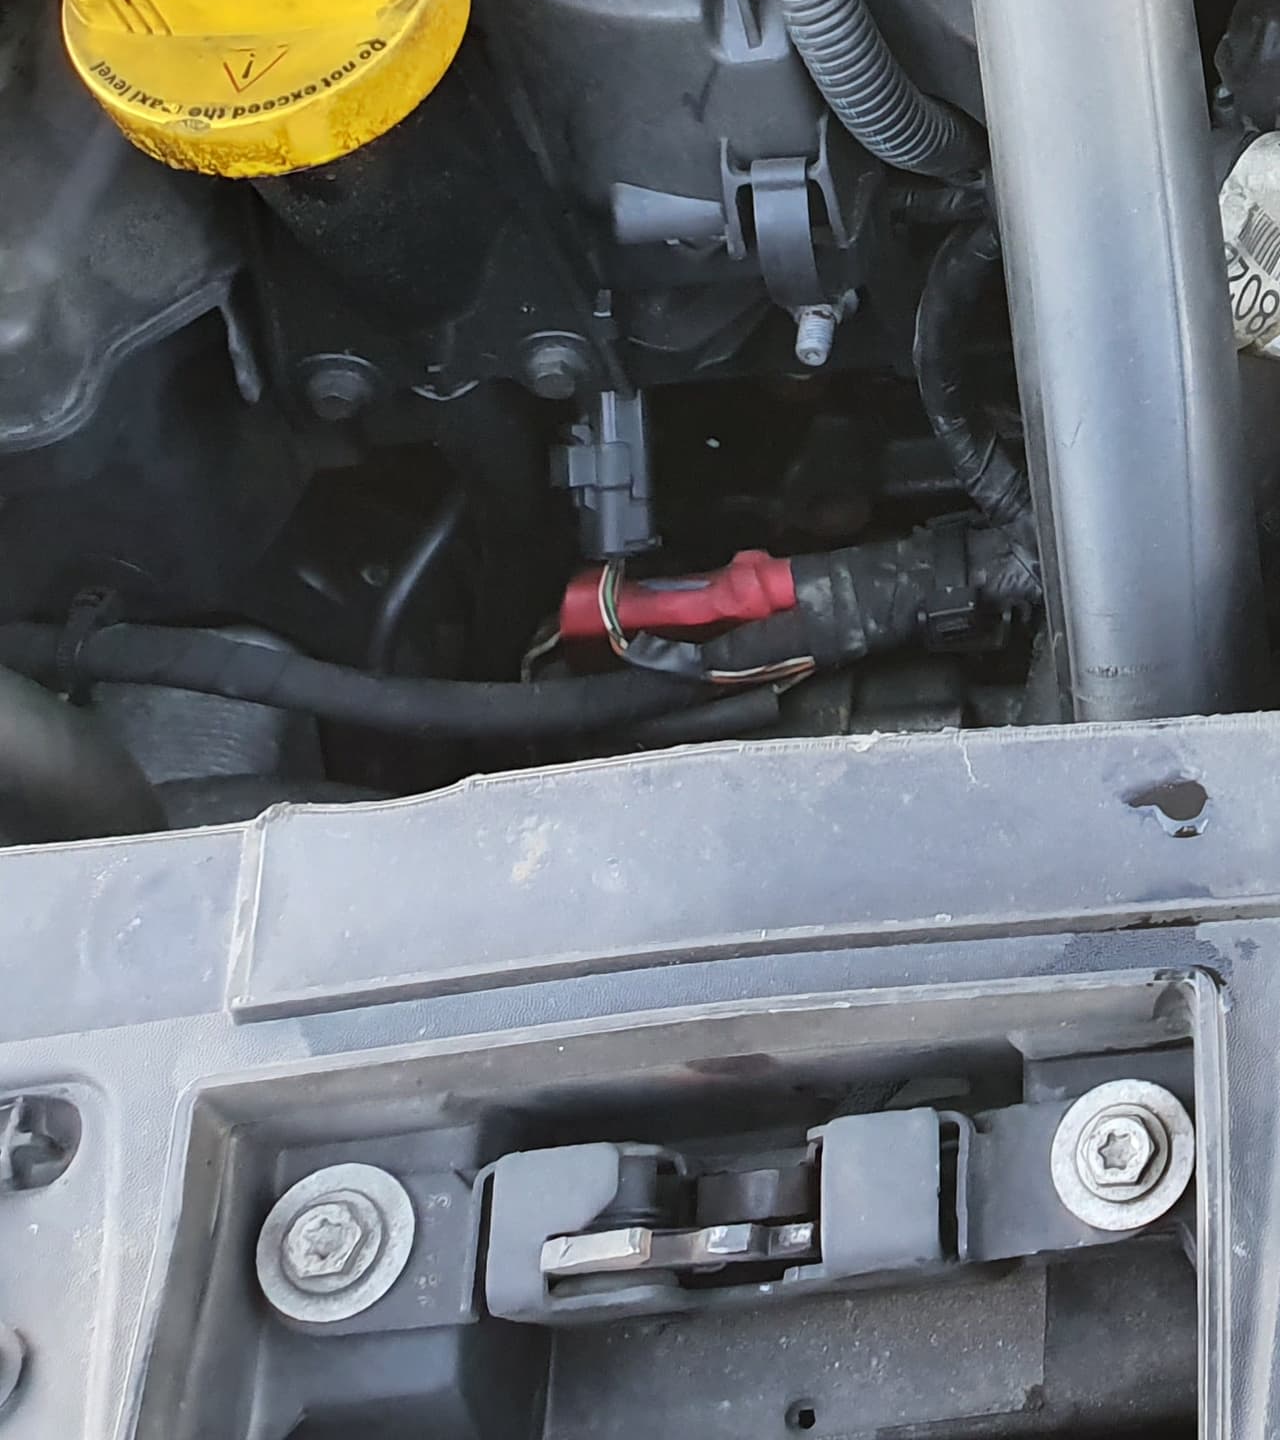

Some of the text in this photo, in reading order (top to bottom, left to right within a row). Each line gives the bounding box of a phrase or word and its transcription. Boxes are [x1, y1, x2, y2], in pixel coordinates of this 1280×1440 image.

[90, 60, 126, 97] level
[324, 60, 358, 92] not
[188, 104, 225, 120] the
[233, 80, 318, 119] exceed
